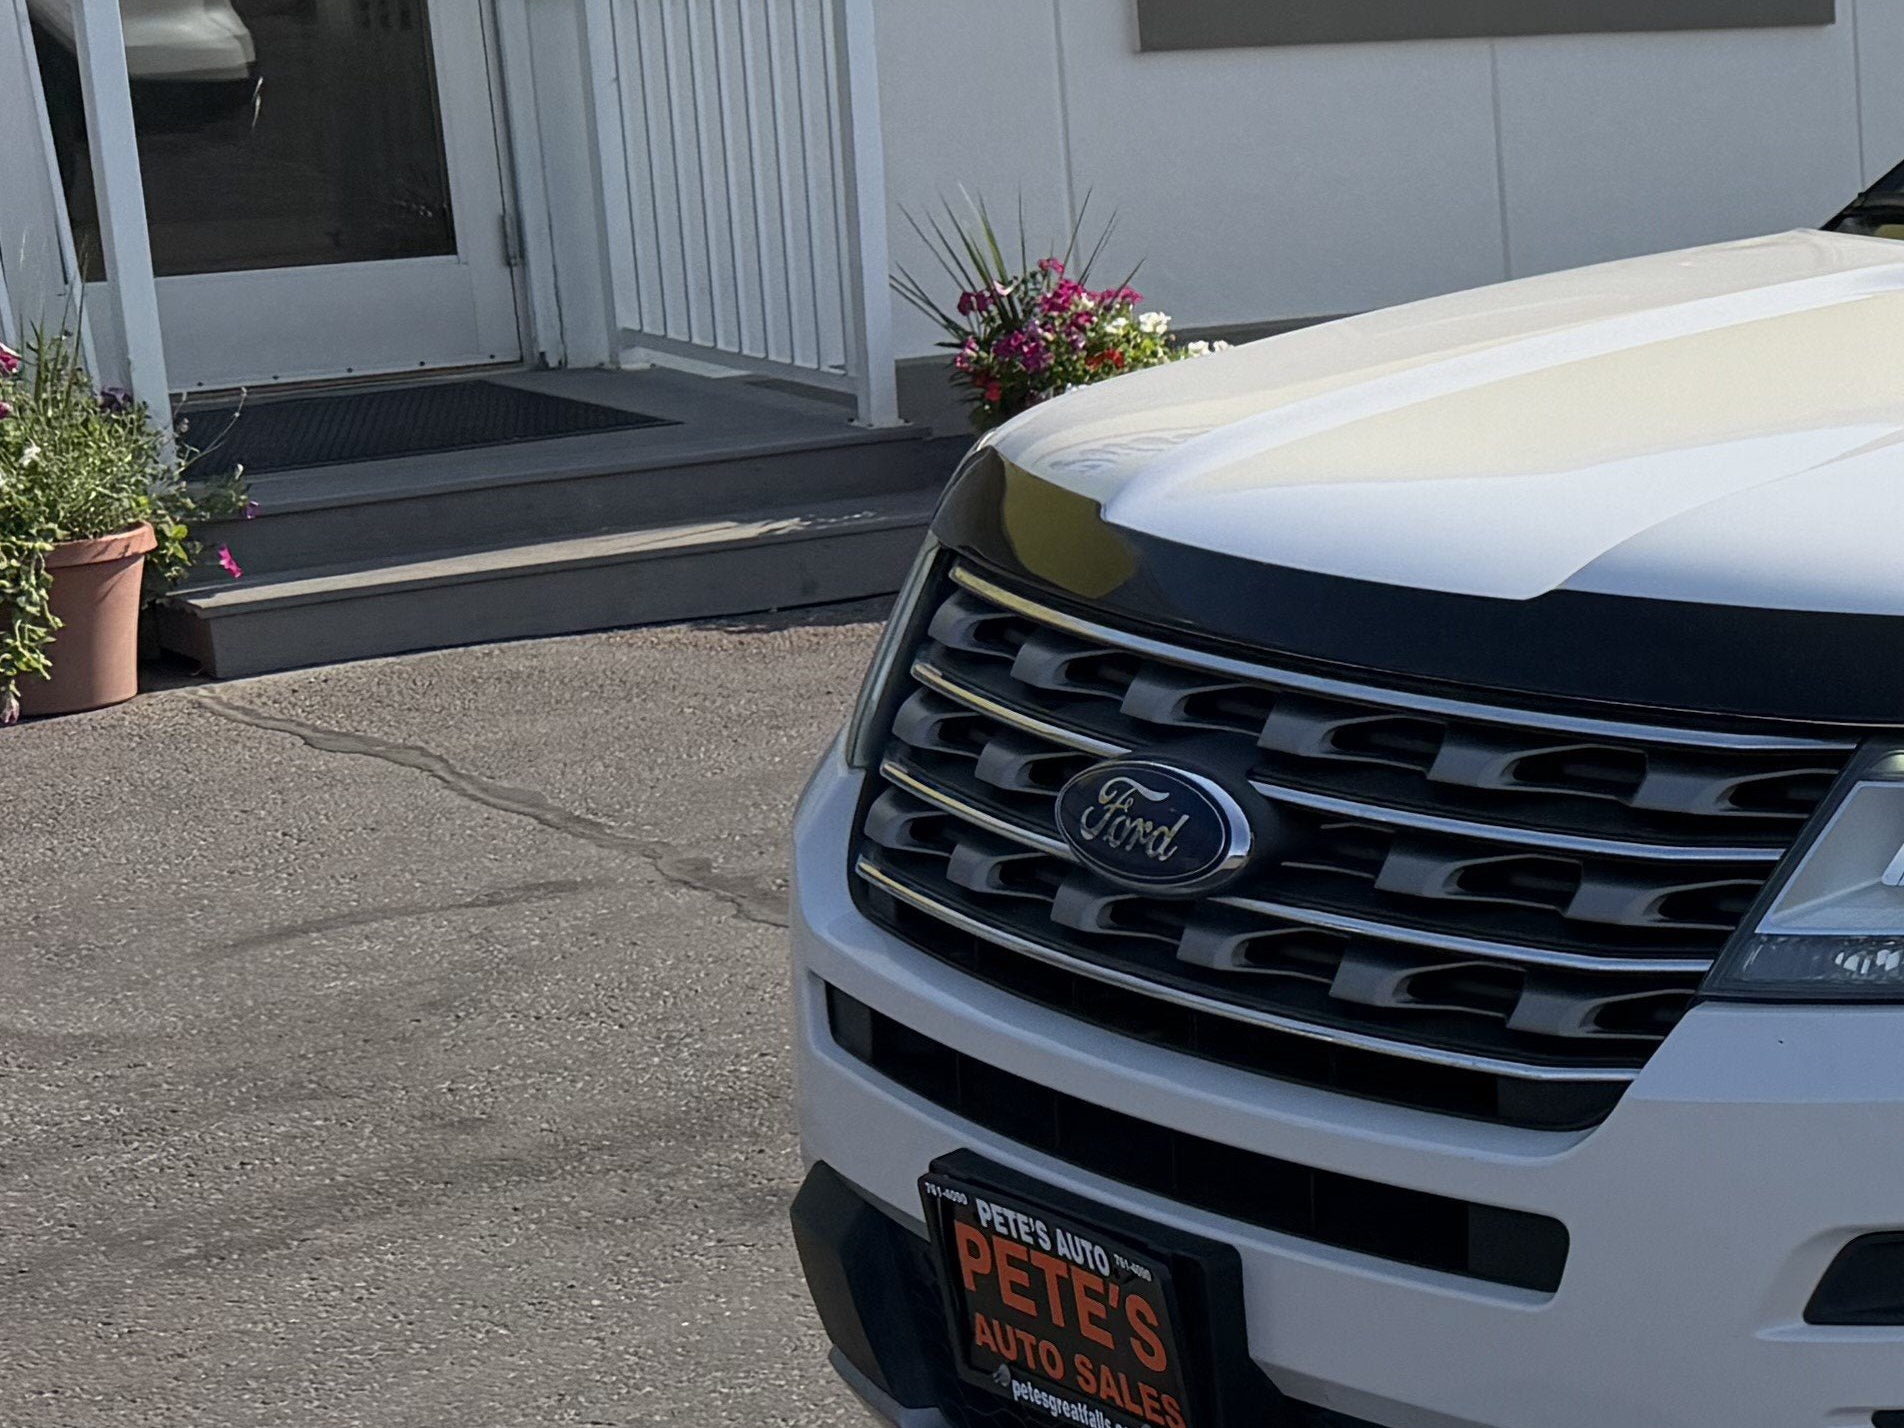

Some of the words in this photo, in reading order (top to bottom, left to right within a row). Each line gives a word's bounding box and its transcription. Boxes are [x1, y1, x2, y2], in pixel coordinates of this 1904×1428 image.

[1080, 776, 1190, 862] Ford
[975, 1196, 1052, 1252] PETE'S
[1056, 1227, 1111, 1278] AUTO
[954, 1219, 1168, 1373] PETE'S
[974, 1312, 1065, 1380] AUTO
